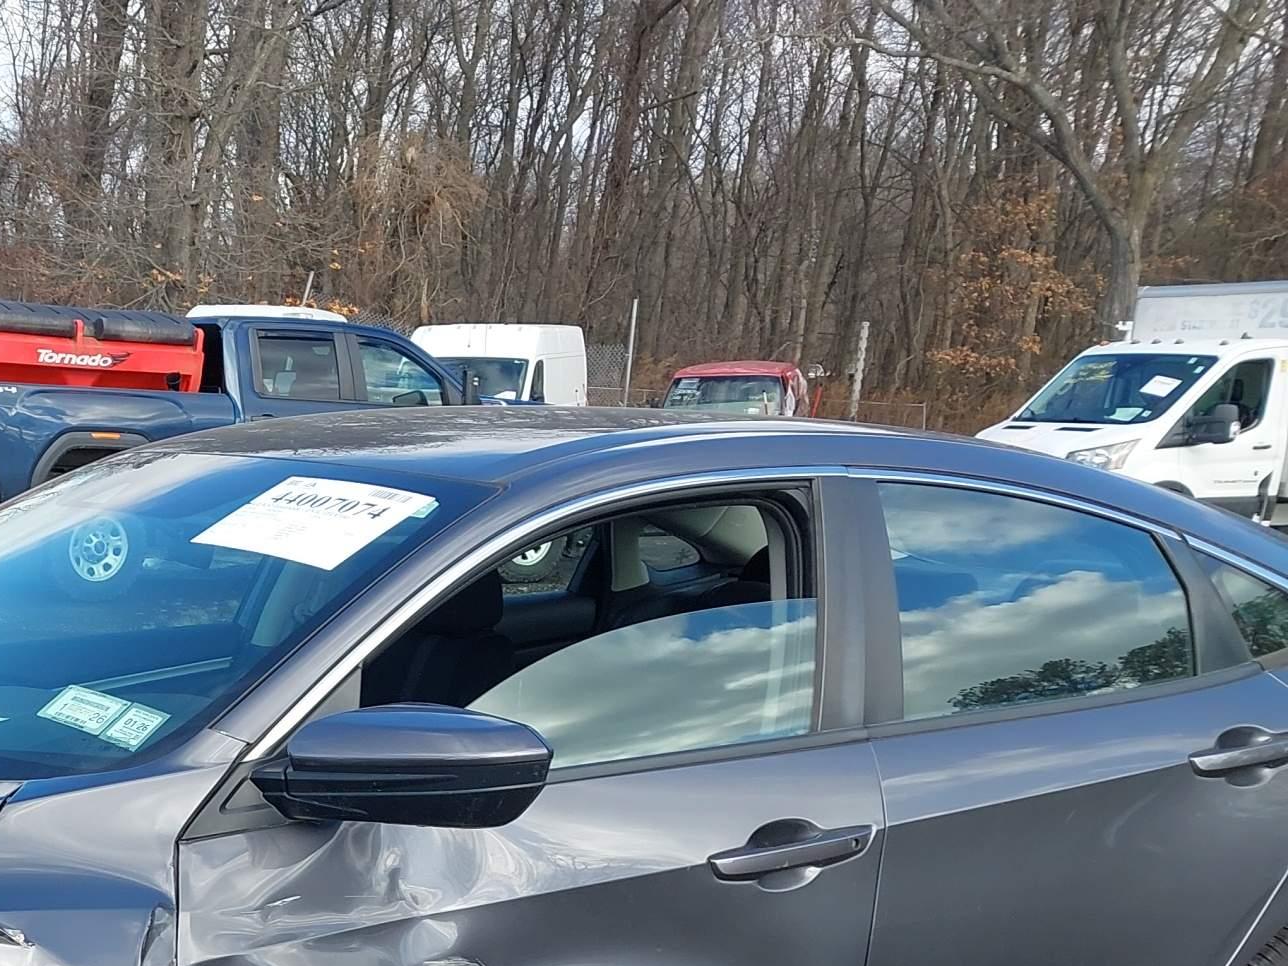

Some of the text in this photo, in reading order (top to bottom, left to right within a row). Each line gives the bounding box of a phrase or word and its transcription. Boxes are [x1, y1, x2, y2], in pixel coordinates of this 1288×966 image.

[36, 348, 113, 367] Tornado
[271, 490, 392, 520] 44007074
[87, 711, 105, 724] 26
[135, 720, 151, 732] 26
